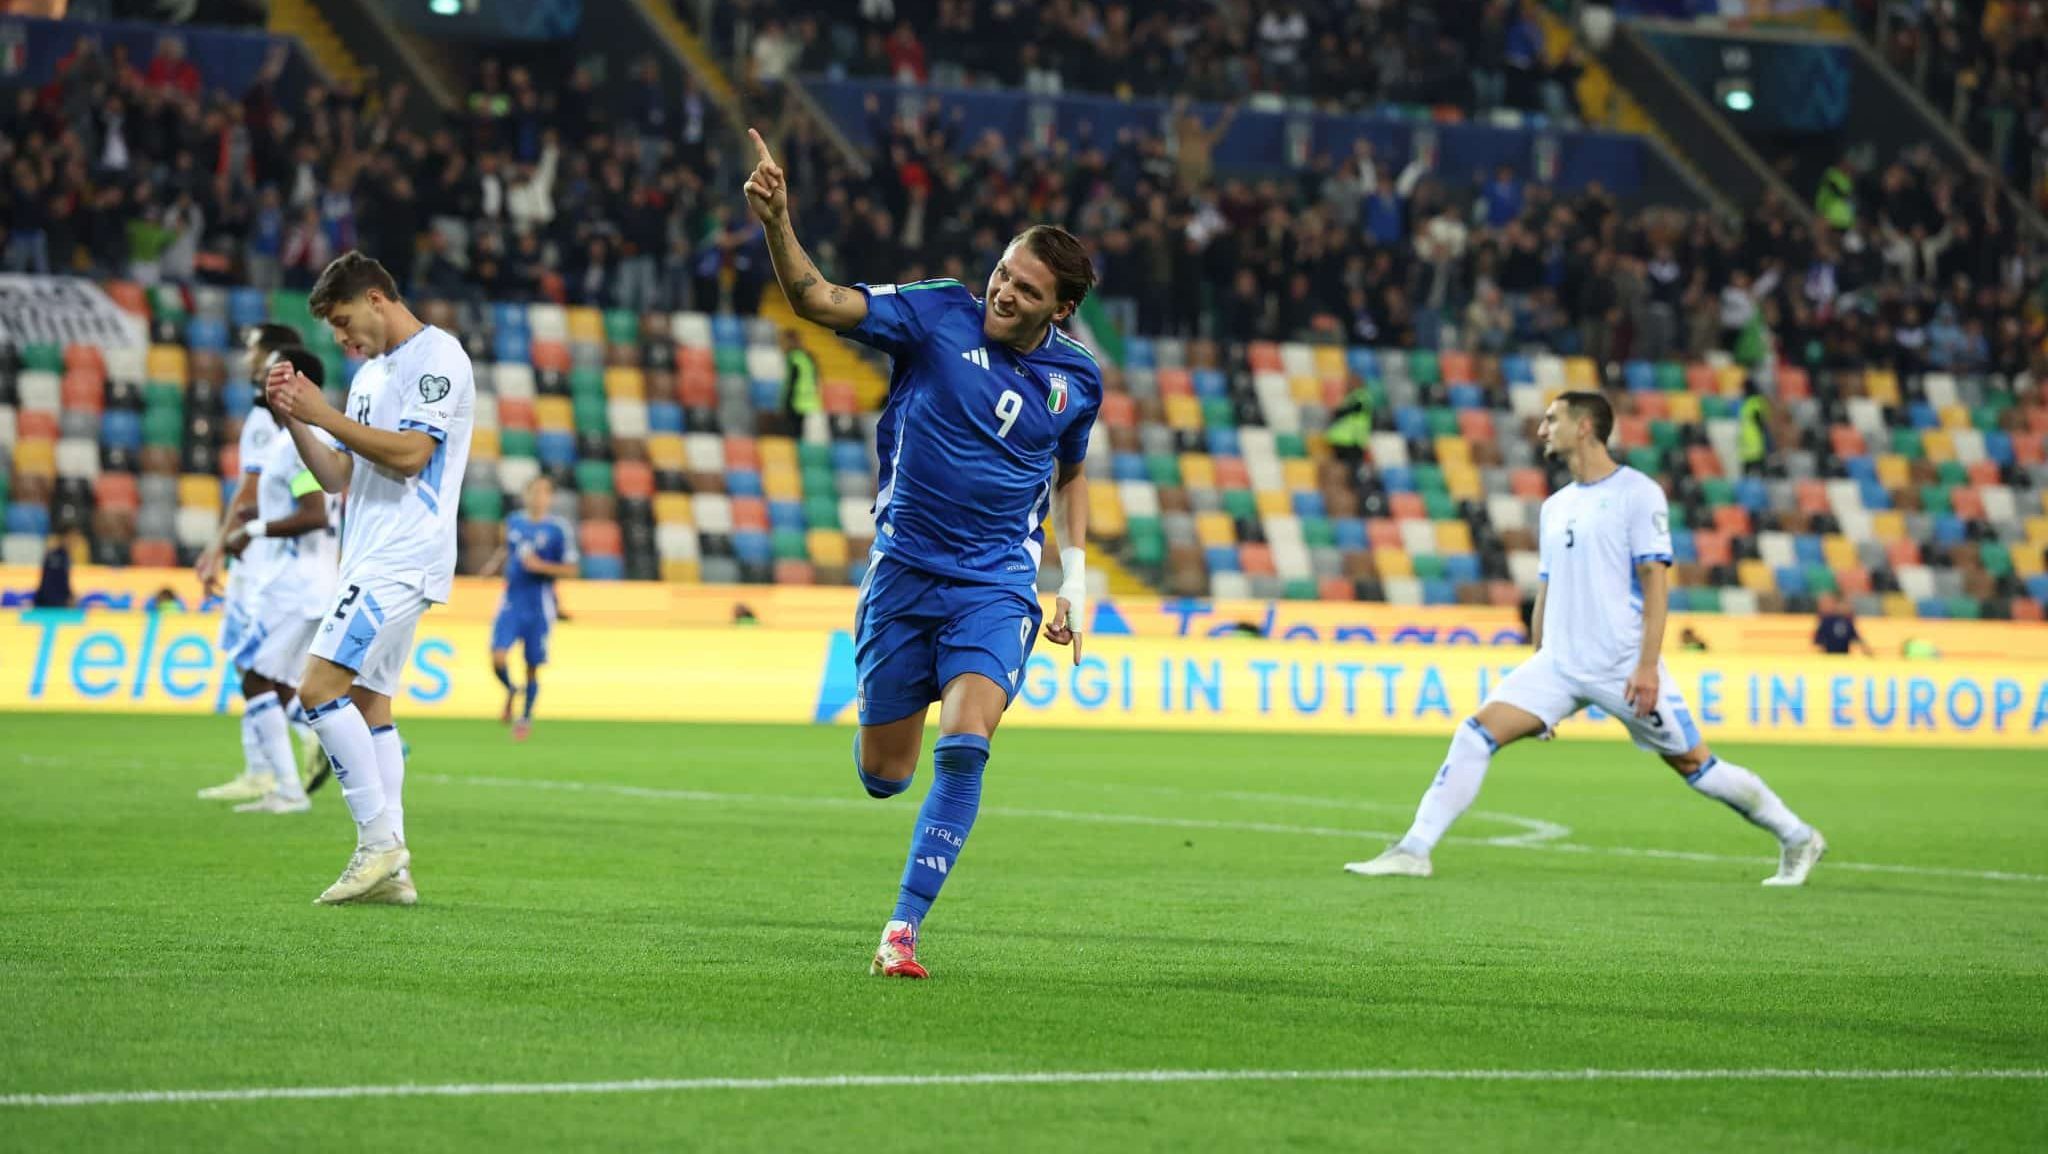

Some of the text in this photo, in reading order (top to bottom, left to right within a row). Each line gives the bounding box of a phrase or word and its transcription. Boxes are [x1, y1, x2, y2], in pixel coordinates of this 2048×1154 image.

[994, 389, 1023, 439] 9
[1565, 520, 1576, 549] 5
[334, 583, 361, 619] 2
[19, 608, 454, 715] Teles
[1018, 655, 1134, 711] GGI
[1161, 659, 1224, 712] IN
[1248, 661, 1453, 717] TUTTA
[1699, 670, 1724, 724] E
[1749, 673, 1807, 726] IN
[925, 826, 963, 849] ITALIA
